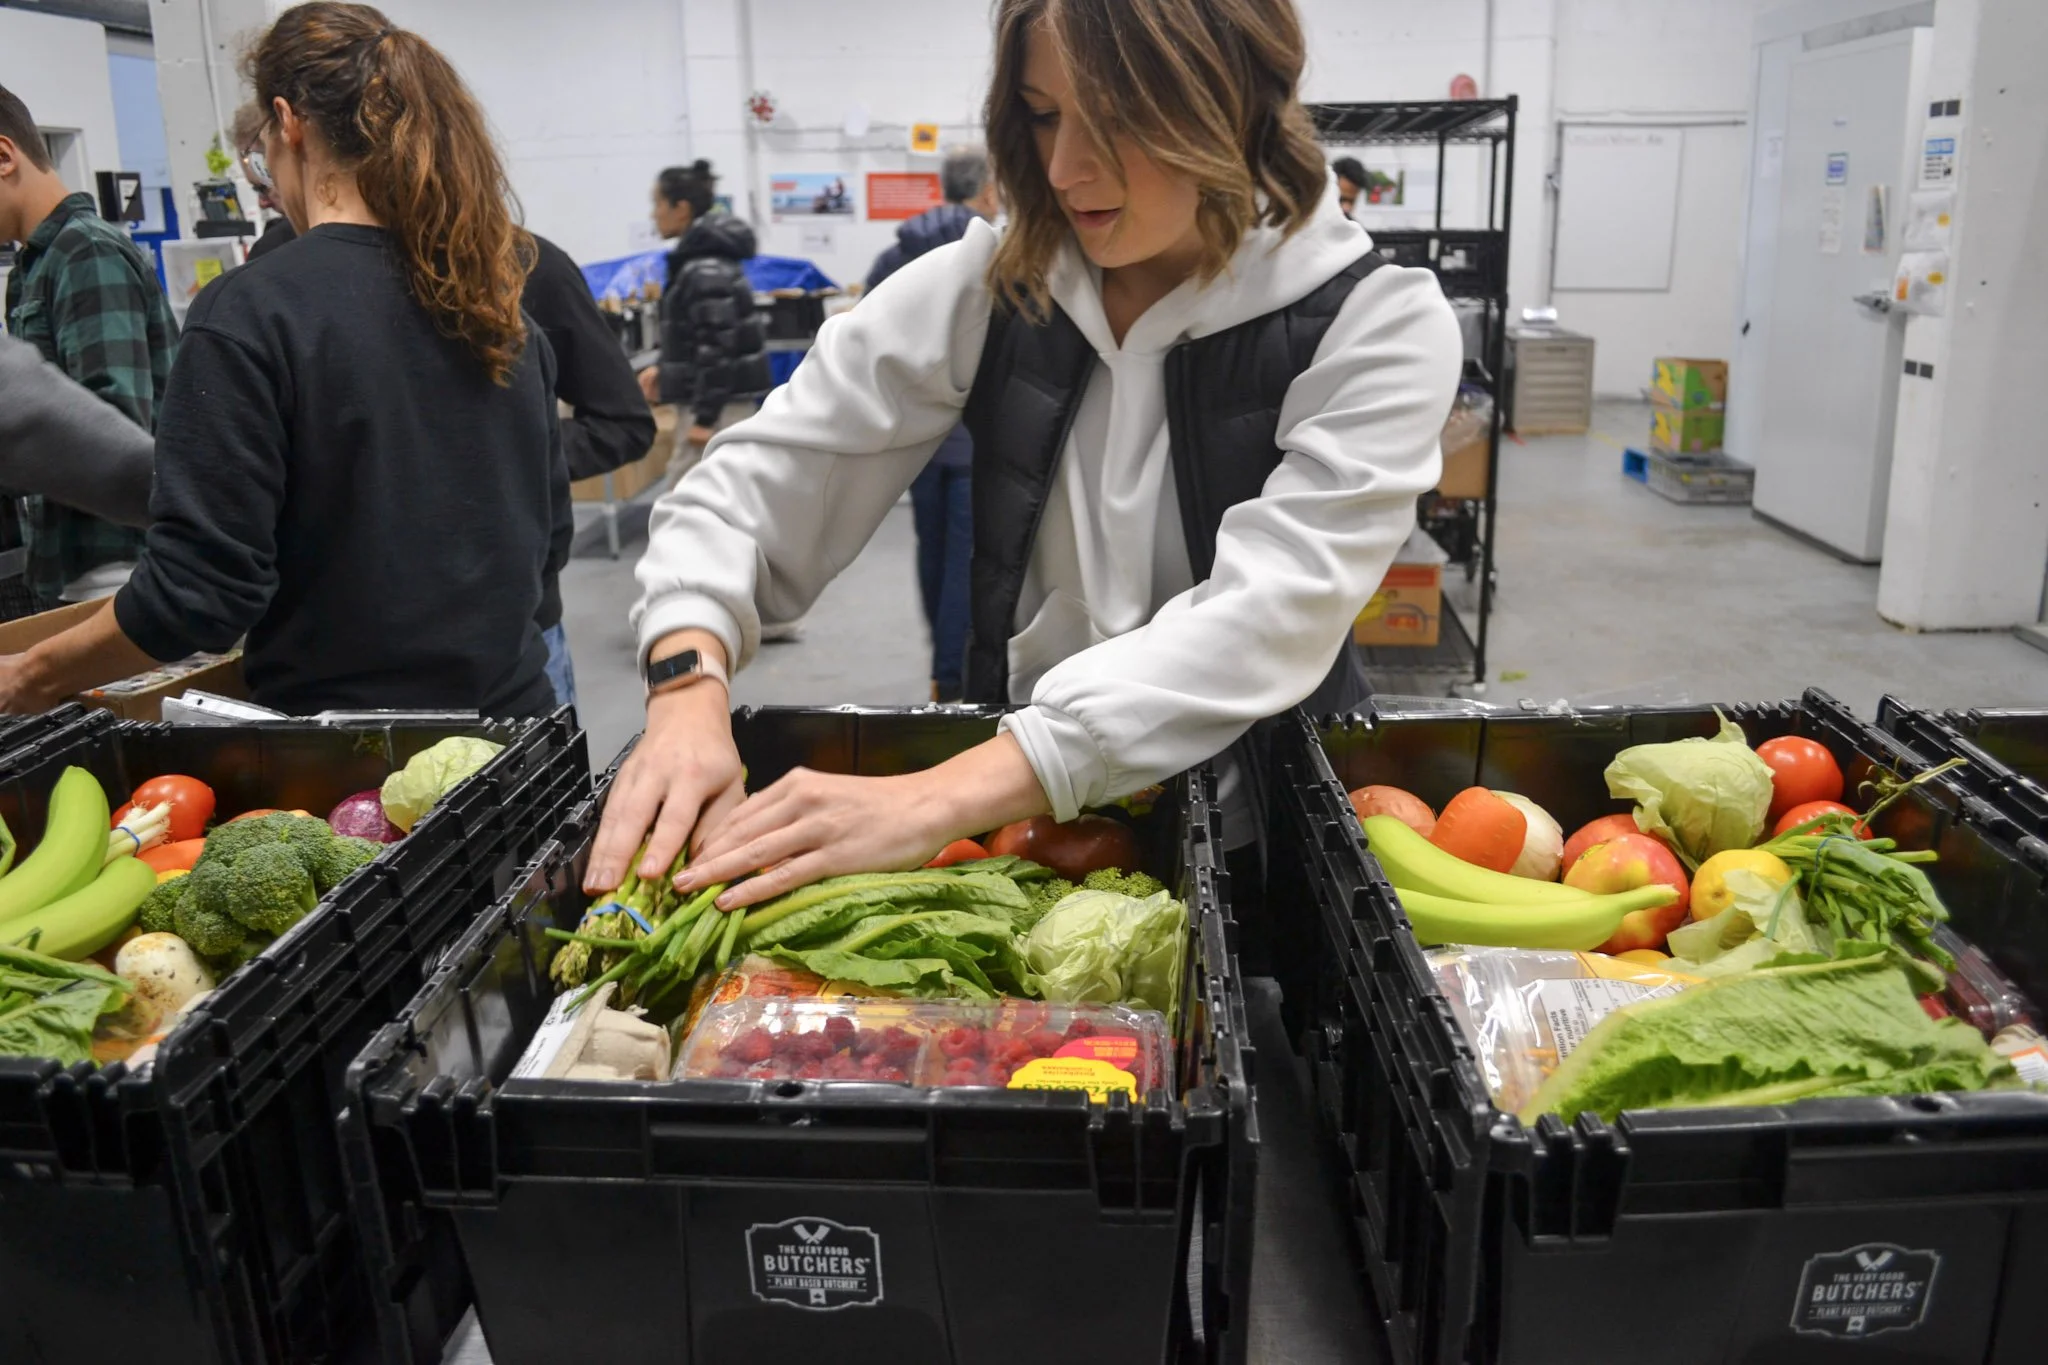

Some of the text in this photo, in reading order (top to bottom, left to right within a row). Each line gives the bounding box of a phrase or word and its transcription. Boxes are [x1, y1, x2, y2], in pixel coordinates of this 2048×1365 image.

[1550, 1010, 1561, 1032] Facts
[1560, 1008, 1574, 1040] nutritive
[778, 1245, 849, 1256] THE VERY GOOD
[775, 1277, 796, 1288] PLANT
[799, 1278, 821, 1288] BASED
[1833, 1273, 1850, 1282] THE
[1853, 1272, 1877, 1281] VERY
